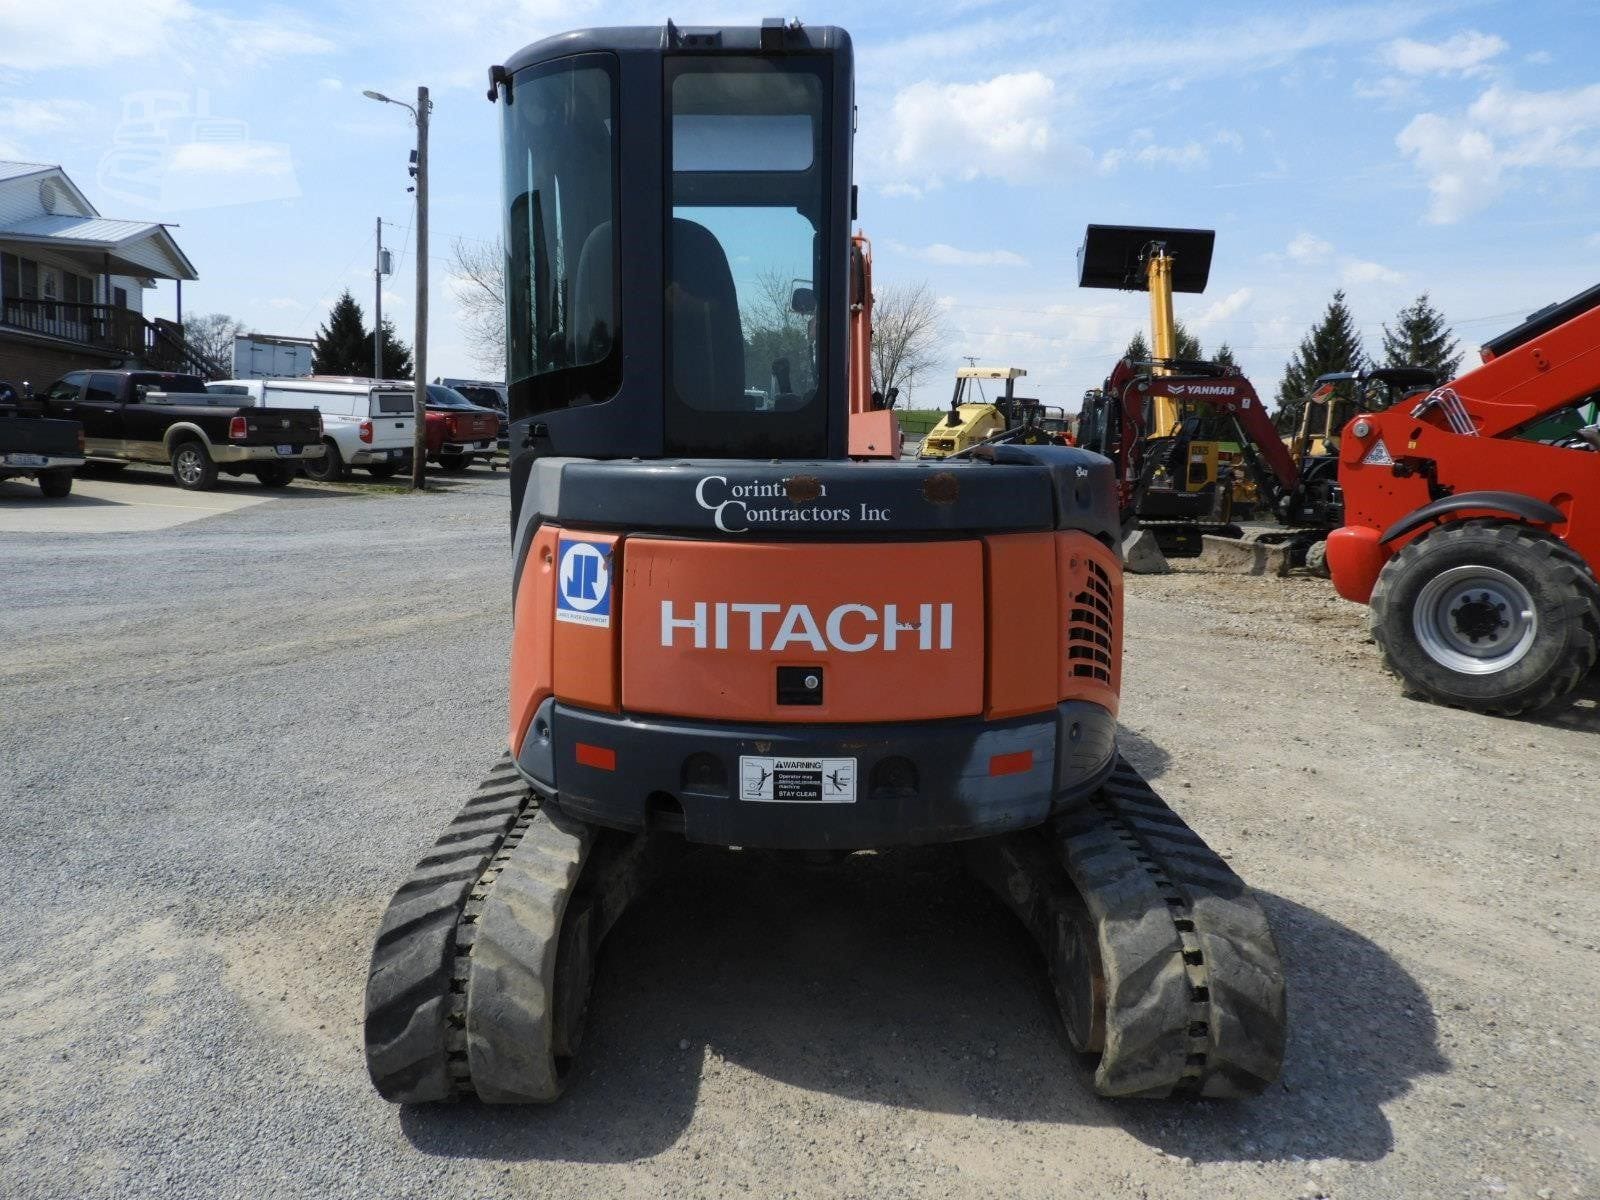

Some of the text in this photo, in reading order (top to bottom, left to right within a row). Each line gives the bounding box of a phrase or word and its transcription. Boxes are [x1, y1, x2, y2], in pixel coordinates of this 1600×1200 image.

[1187, 385, 1235, 395] YANMAR
[695, 475, 826, 510] Corintn
[714, 500, 892, 533] Contractors Inc
[661, 600, 953, 652] HITACHI
[783, 761, 822, 769] WARNING
